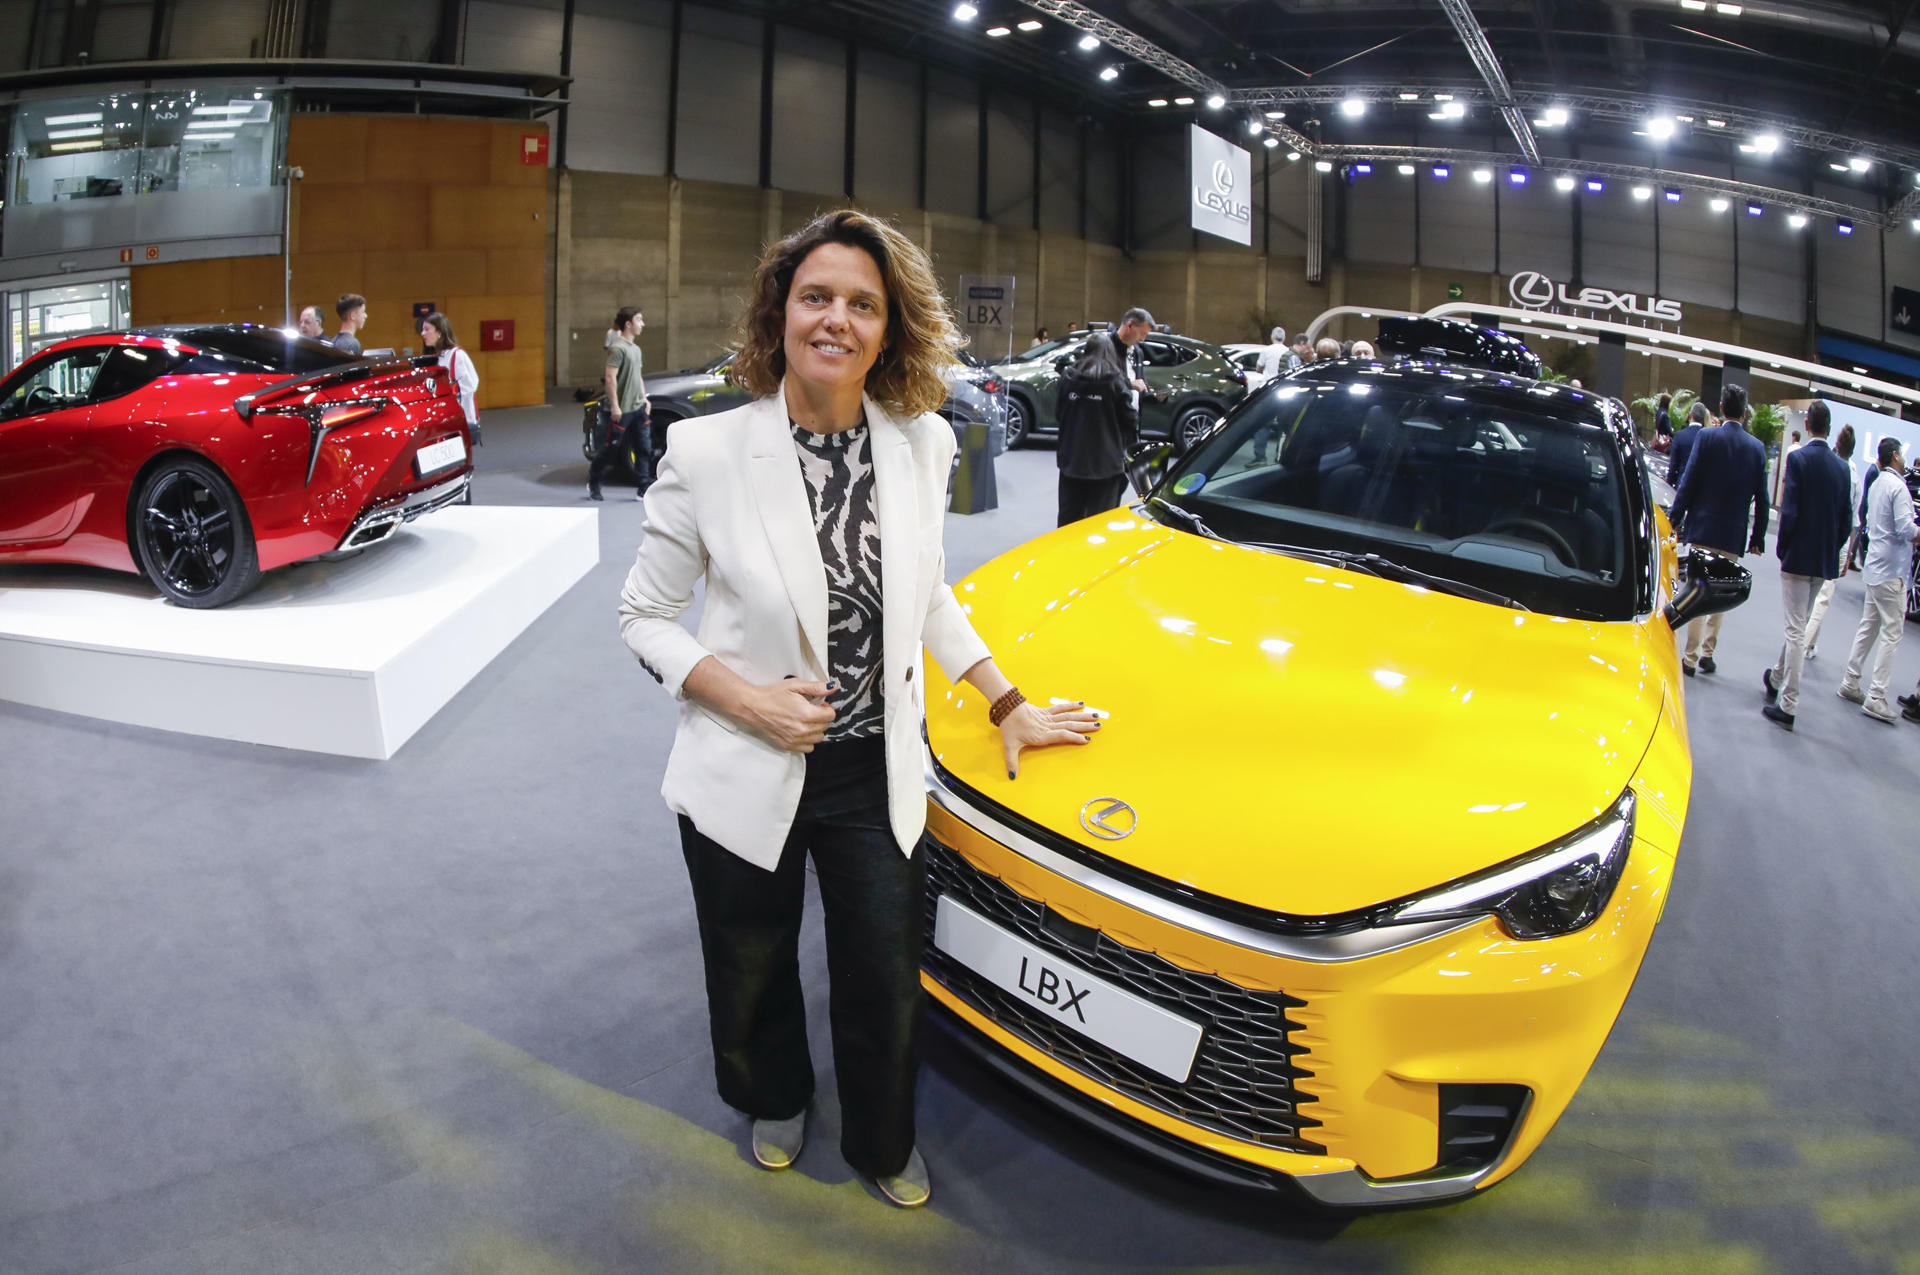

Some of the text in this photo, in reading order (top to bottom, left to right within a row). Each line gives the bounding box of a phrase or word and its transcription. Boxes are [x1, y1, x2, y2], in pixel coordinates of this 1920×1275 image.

[1195, 185, 1250, 222] LEXUS
[967, 304, 1002, 325] LBX
[1558, 283, 1682, 321] LEXUS
[1019, 956, 1091, 1024] LBX
